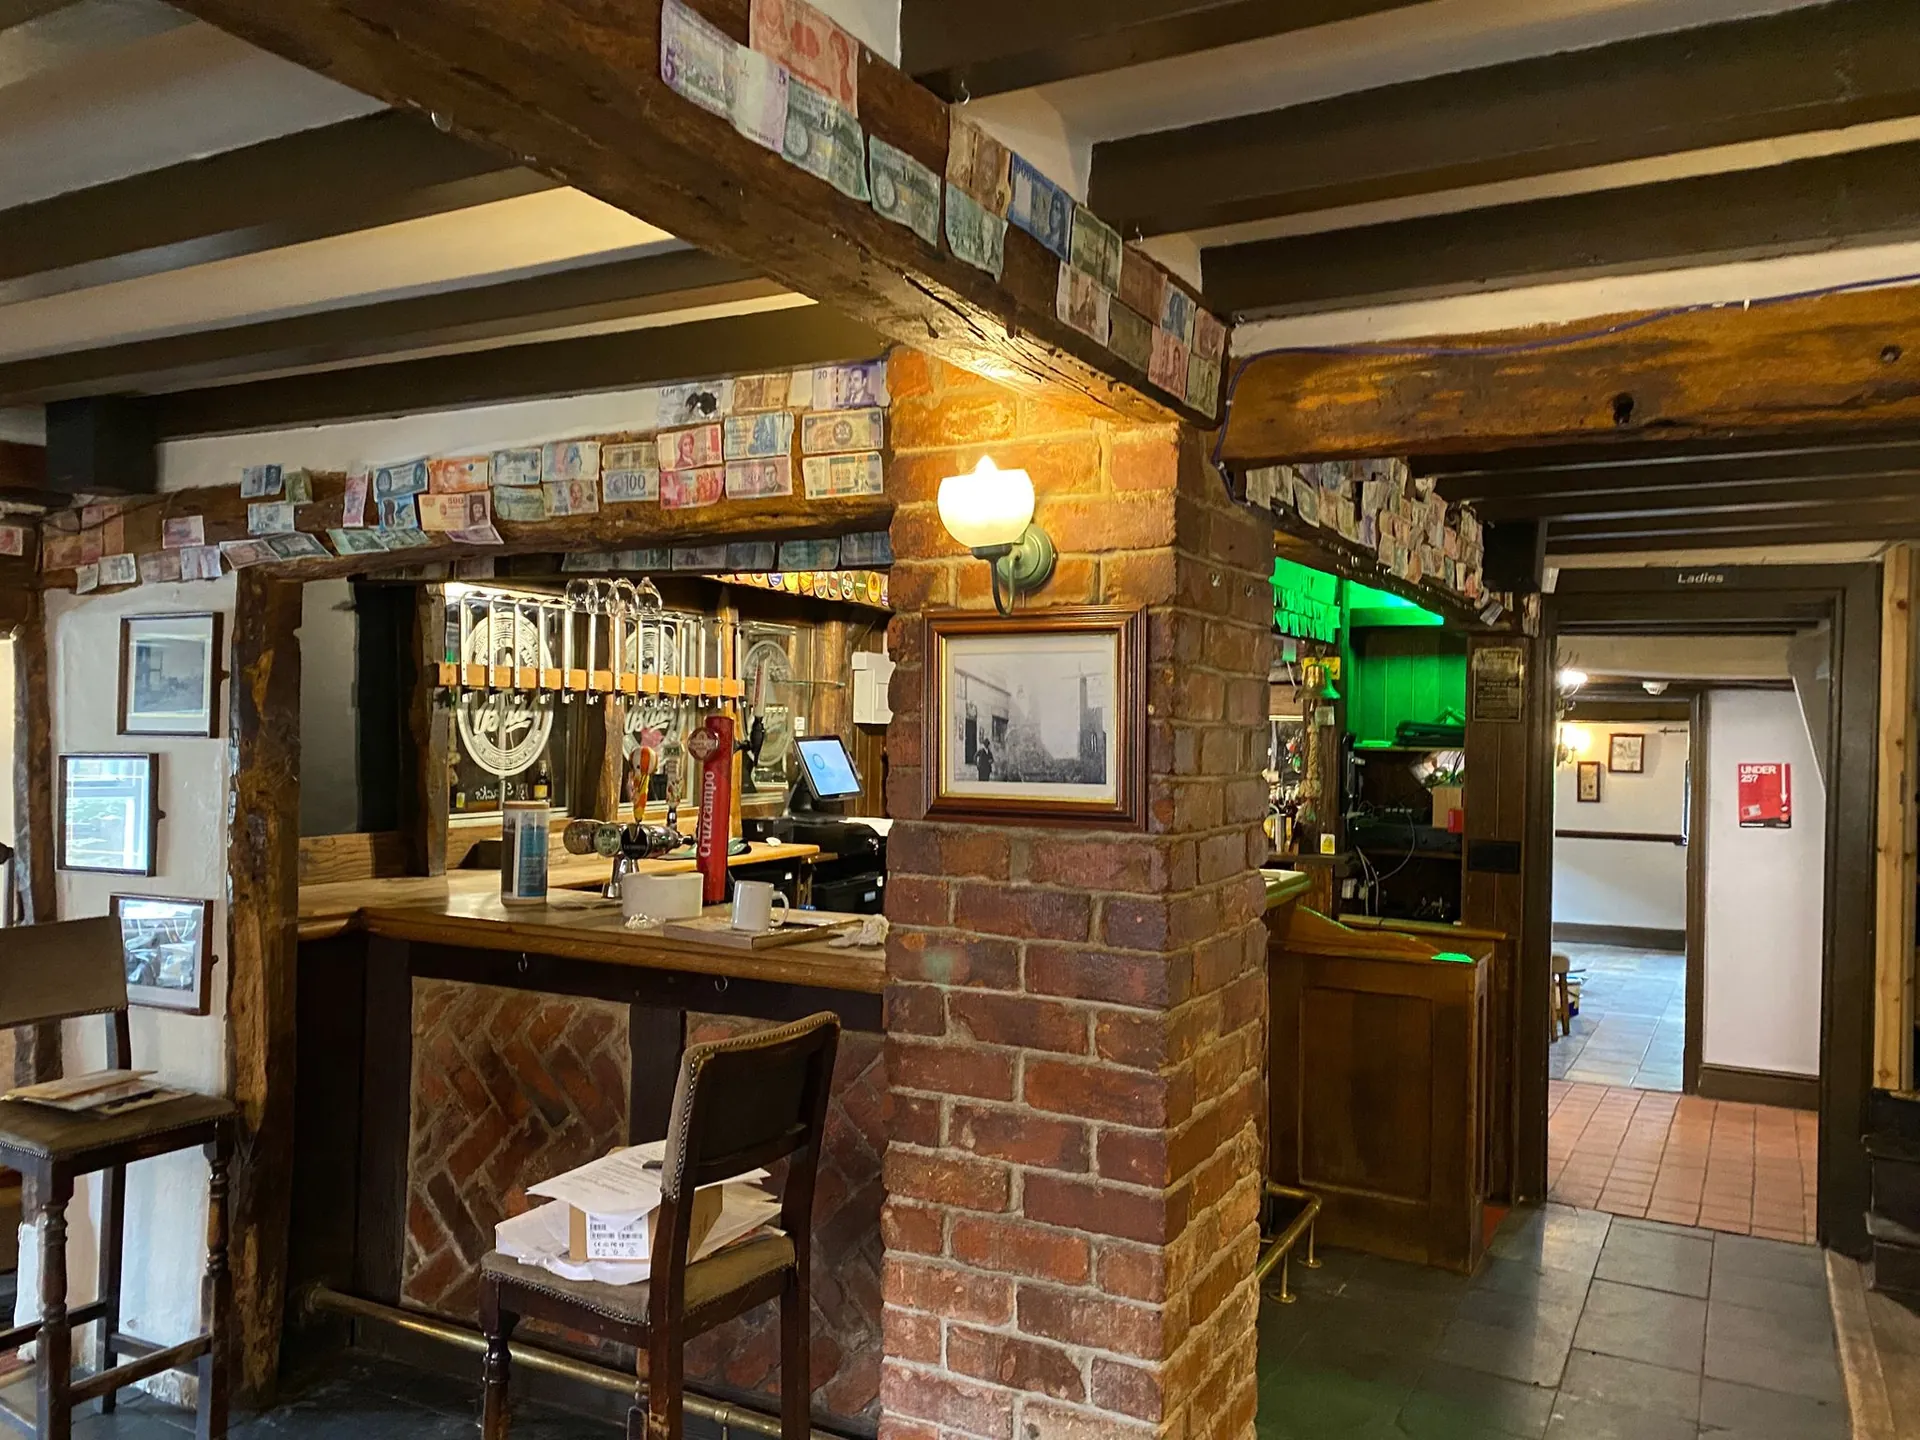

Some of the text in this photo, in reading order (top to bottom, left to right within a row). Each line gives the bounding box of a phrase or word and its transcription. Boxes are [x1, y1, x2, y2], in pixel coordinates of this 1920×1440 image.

[663, 47, 676, 83] 5
[817, 370, 828, 380] 20
[624, 474, 646, 491] 100
[1677, 572, 1724, 585] Ladies
[1740, 765, 1777, 775] UNDER
[699, 771, 717, 858] Cruzcampo
